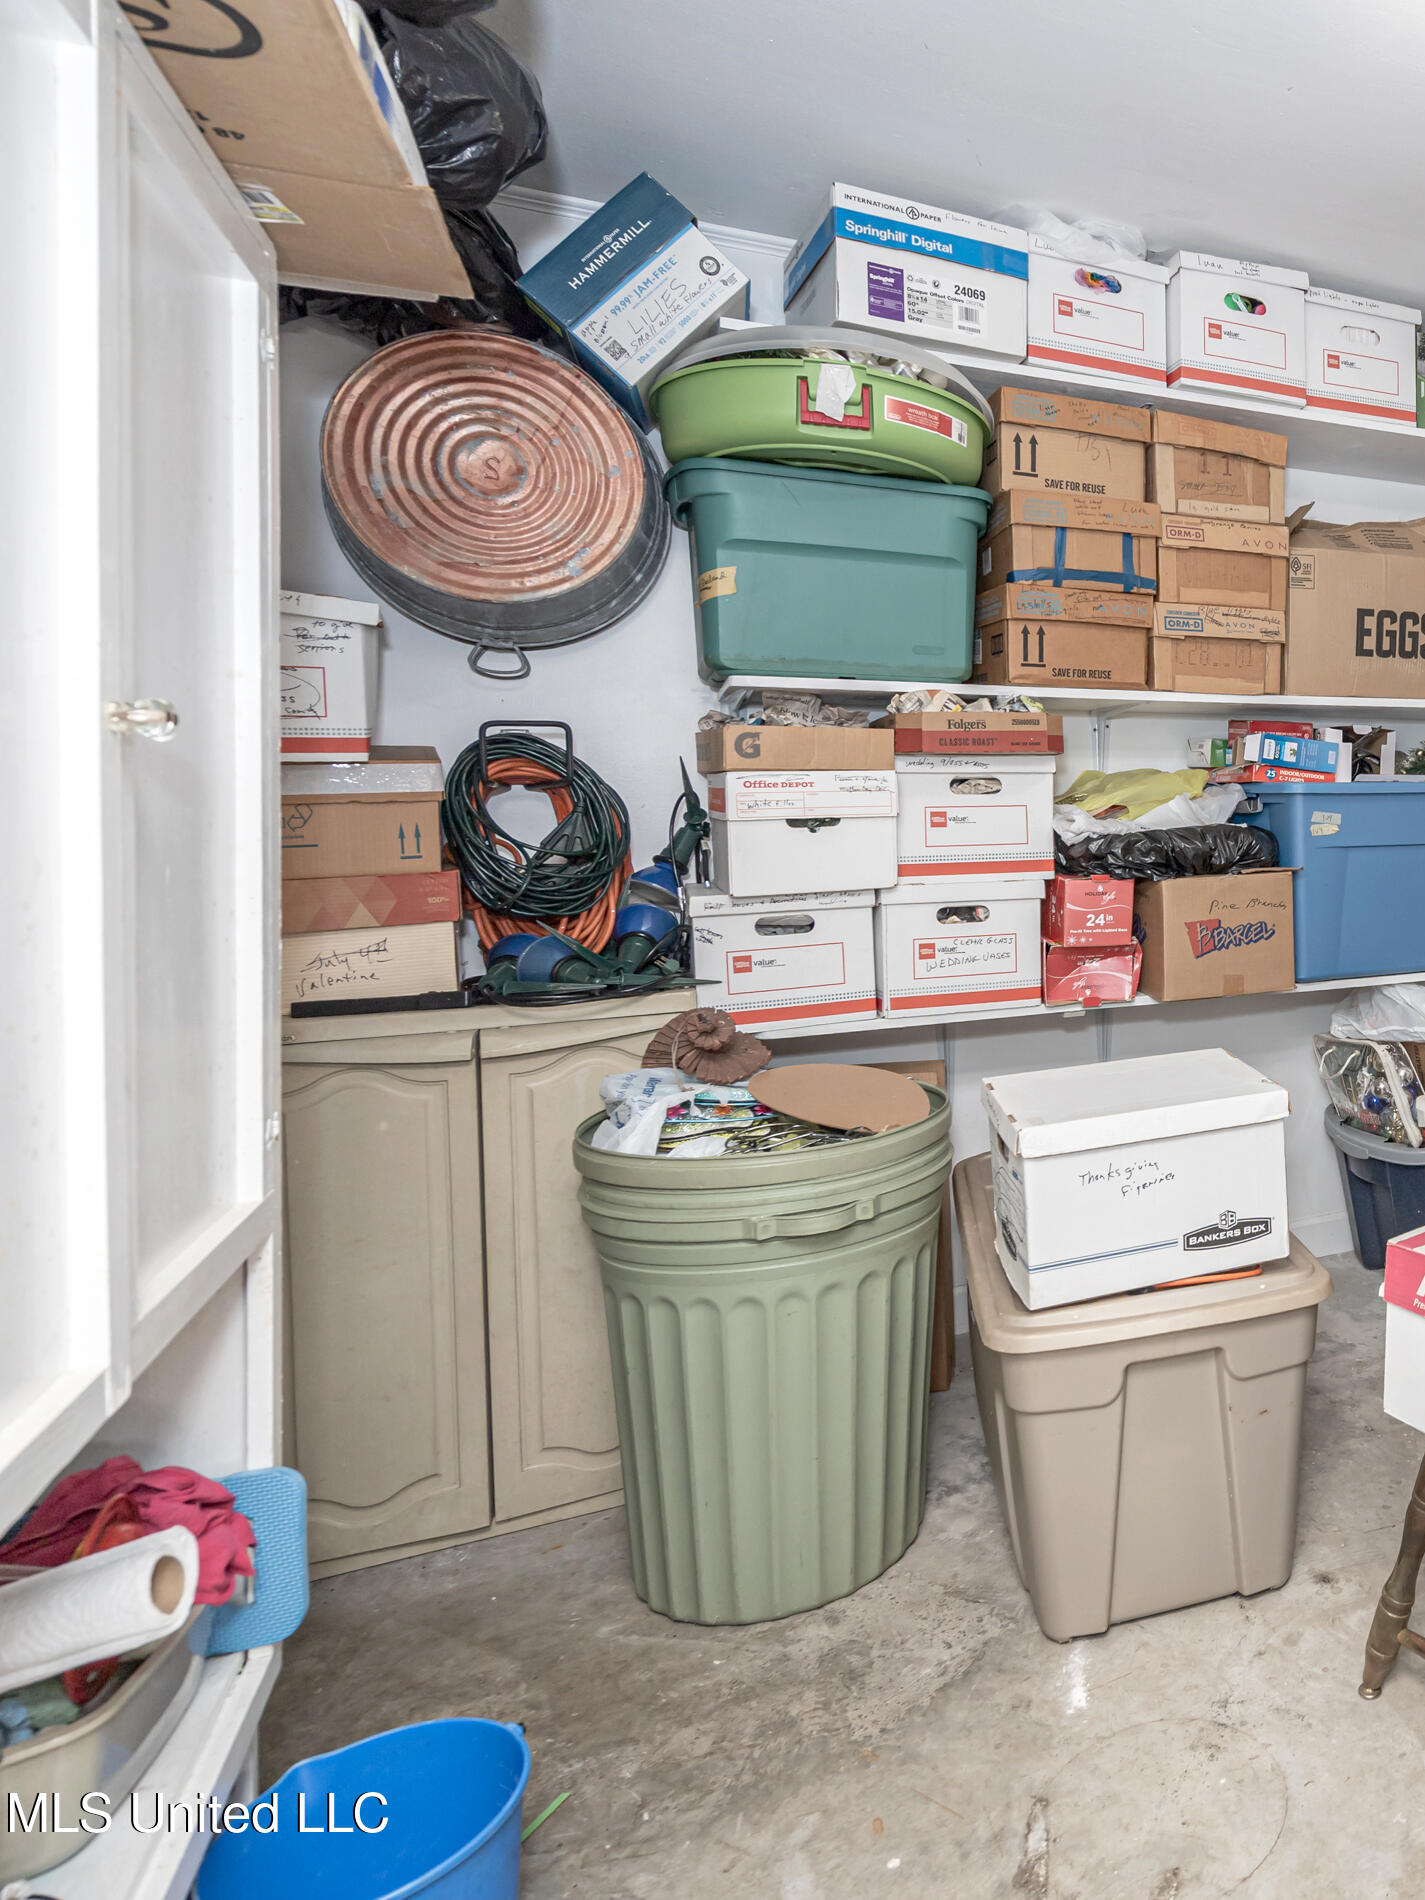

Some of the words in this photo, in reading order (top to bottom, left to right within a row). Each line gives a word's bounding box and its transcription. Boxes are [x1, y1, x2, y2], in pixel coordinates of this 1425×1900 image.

[844, 193, 904, 214] INTERNATIONAL
[920, 212, 942, 223] PAPER
[845, 219, 906, 243] Springhill
[911, 234, 953, 255] Digital
[568, 219, 650, 290] HAMMERMILL
[954, 285, 986, 301] 24069
[626, 278, 687, 334] LILIES
[1045, 479, 1063, 490] SAVE
[1065, 481, 1080, 491] FOR
[1082, 483, 1106, 494] REUSE
[1169, 529, 1202, 539] ORM-D
[1242, 538, 1287, 551] AVON
[1100, 603, 1148, 616] AVON
[1167, 619, 1200, 629] ORM-D
[1052, 667, 1070, 678] SAVE
[1072, 668, 1087, 679] FOR
[1088, 669, 1112, 680] REUSE
[947, 719, 987, 731] Folgers
[733, 731, 762, 759] G
[939, 737, 969, 747] CLASSIC
[972, 737, 997, 747] ROAST
[743, 780, 779, 789] Office
[1086, 913, 1106, 927] 24
[1213, 921, 1276, 951] BARCEL
[296, 970, 381, 997] Valentine
[1188, 1228, 1241, 1246] BANKERS
[1243, 1223, 1266, 1236] BOX
